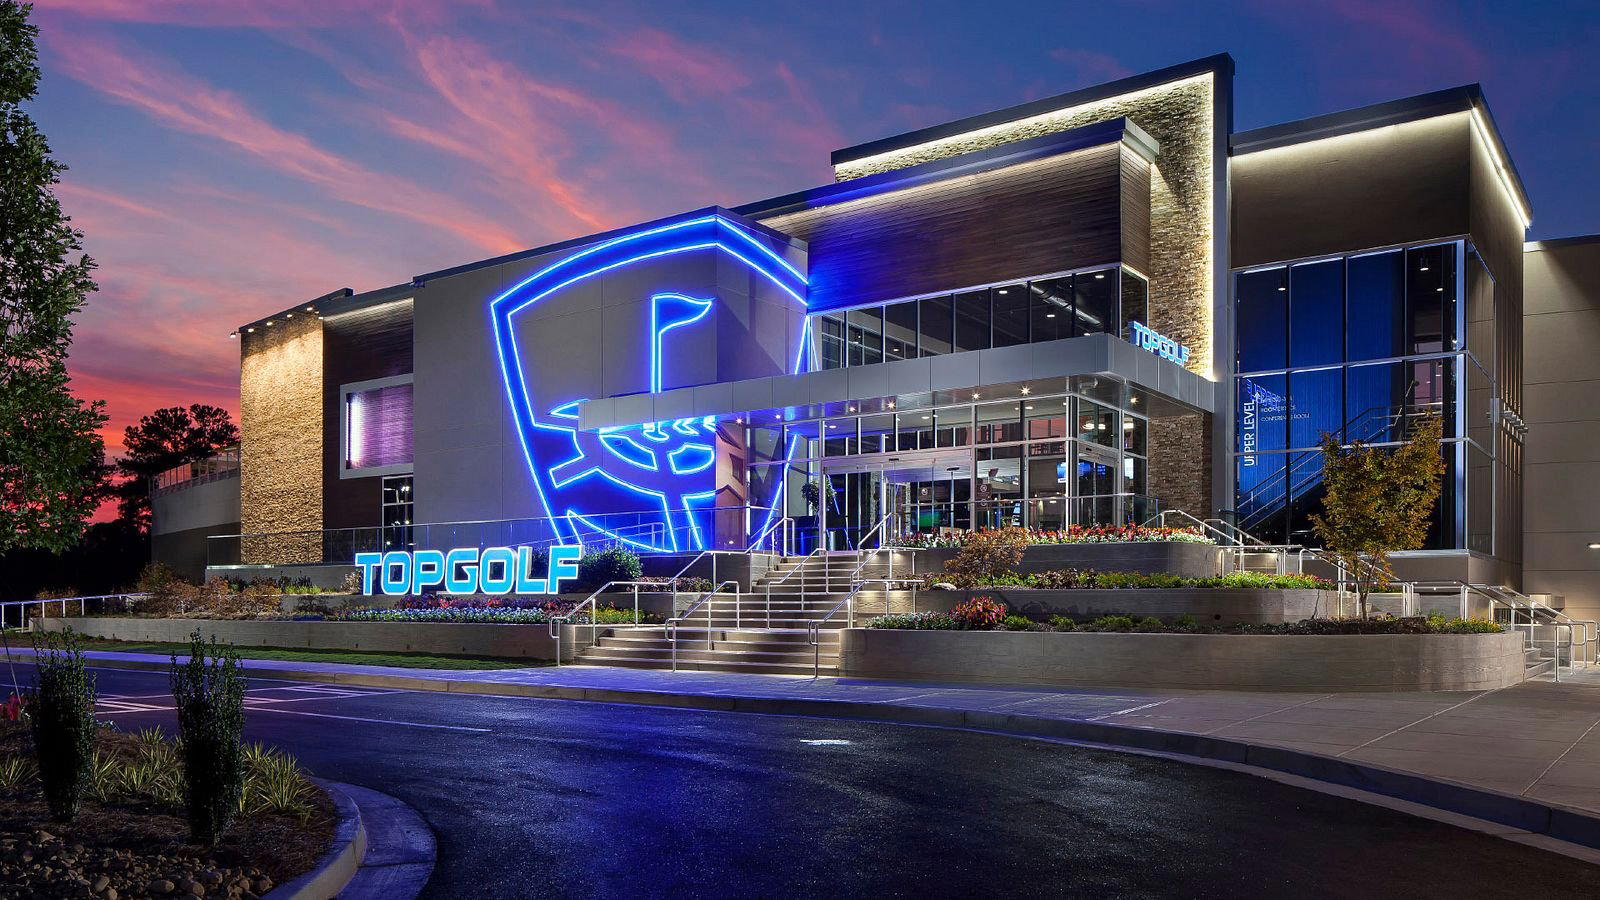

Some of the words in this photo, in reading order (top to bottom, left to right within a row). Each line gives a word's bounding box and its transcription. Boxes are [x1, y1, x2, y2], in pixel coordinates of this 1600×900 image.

[1133, 320, 1190, 367] TOPGOLF
[1243, 399, 1255, 430] LEVEL
[355, 544, 583, 596] TOPGOLF
